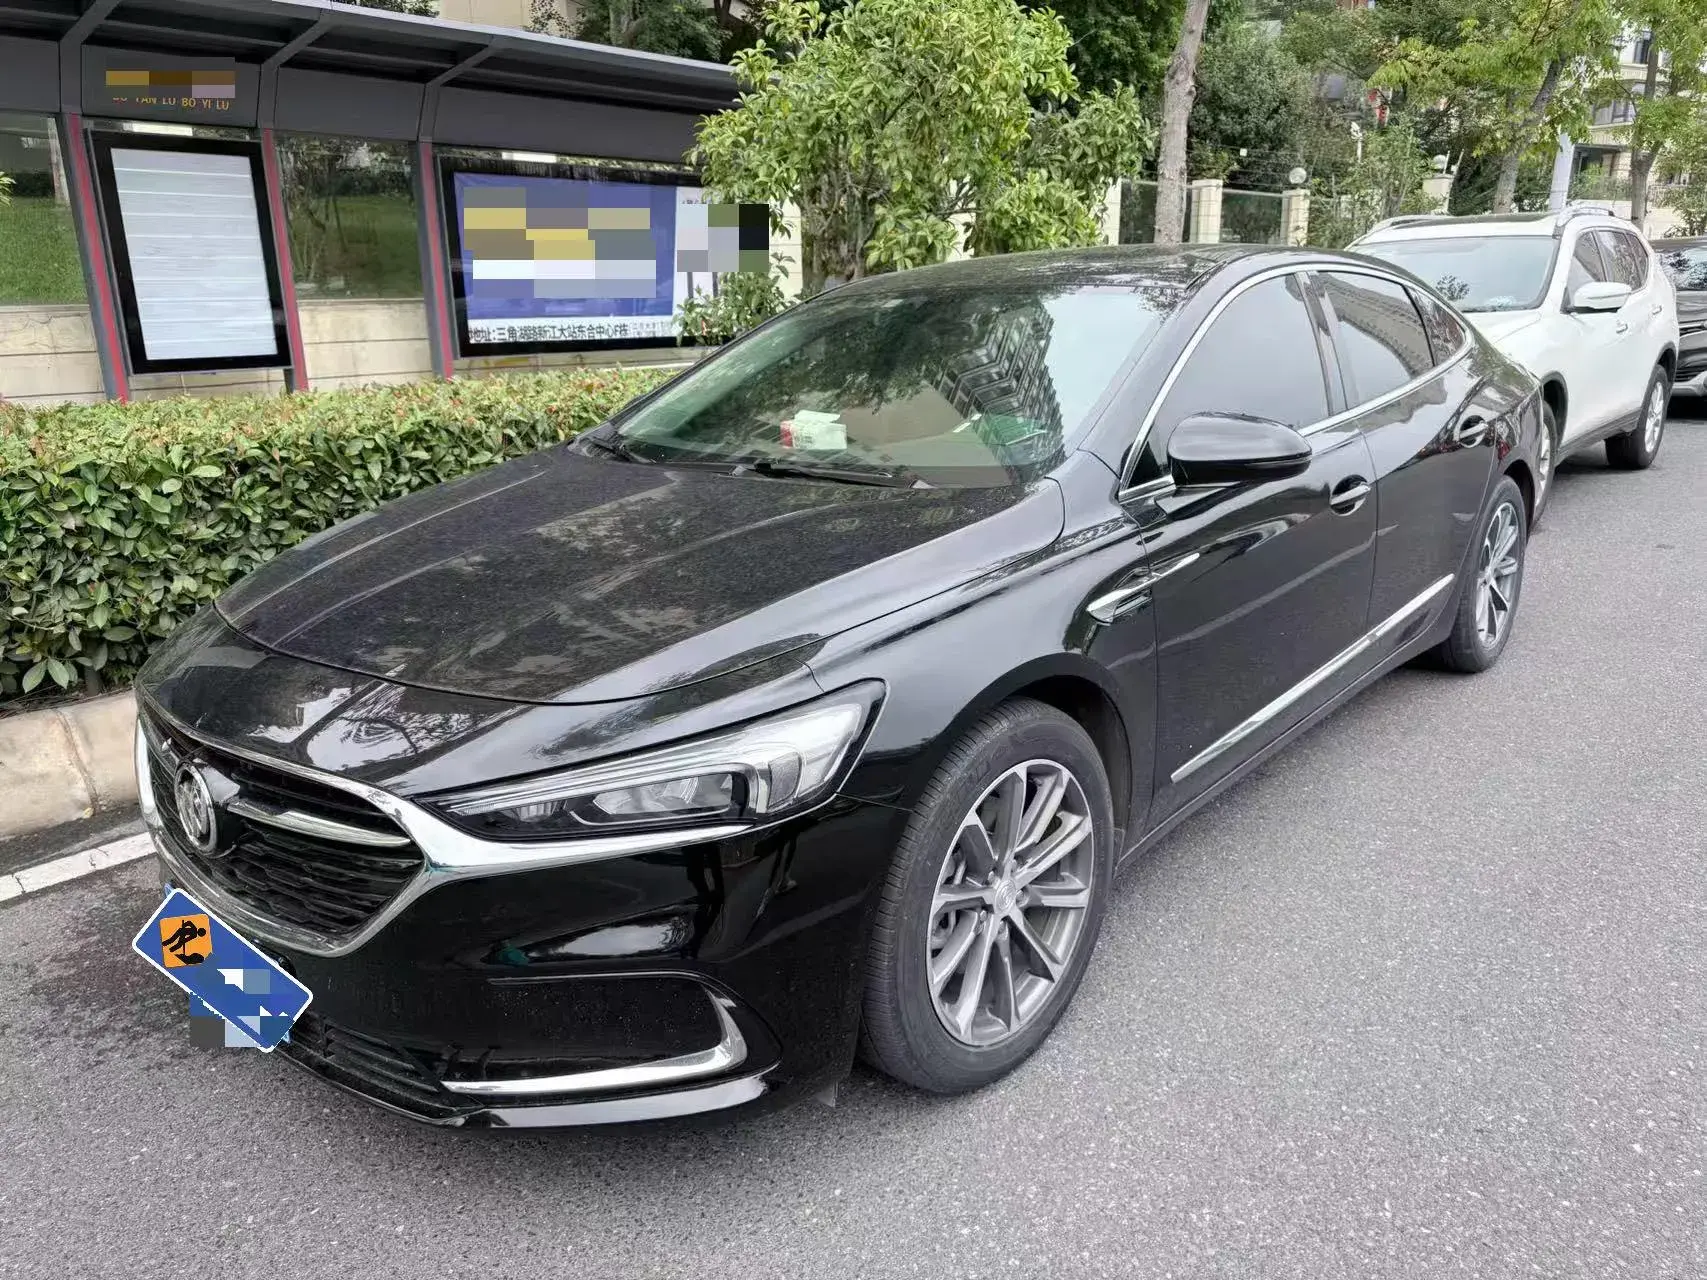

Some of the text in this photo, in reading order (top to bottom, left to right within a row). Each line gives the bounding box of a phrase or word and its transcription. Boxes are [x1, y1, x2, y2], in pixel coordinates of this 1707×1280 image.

[181, 98, 197, 108] BO
[202, 98, 212, 109] YI
[216, 100, 230, 111] LU
